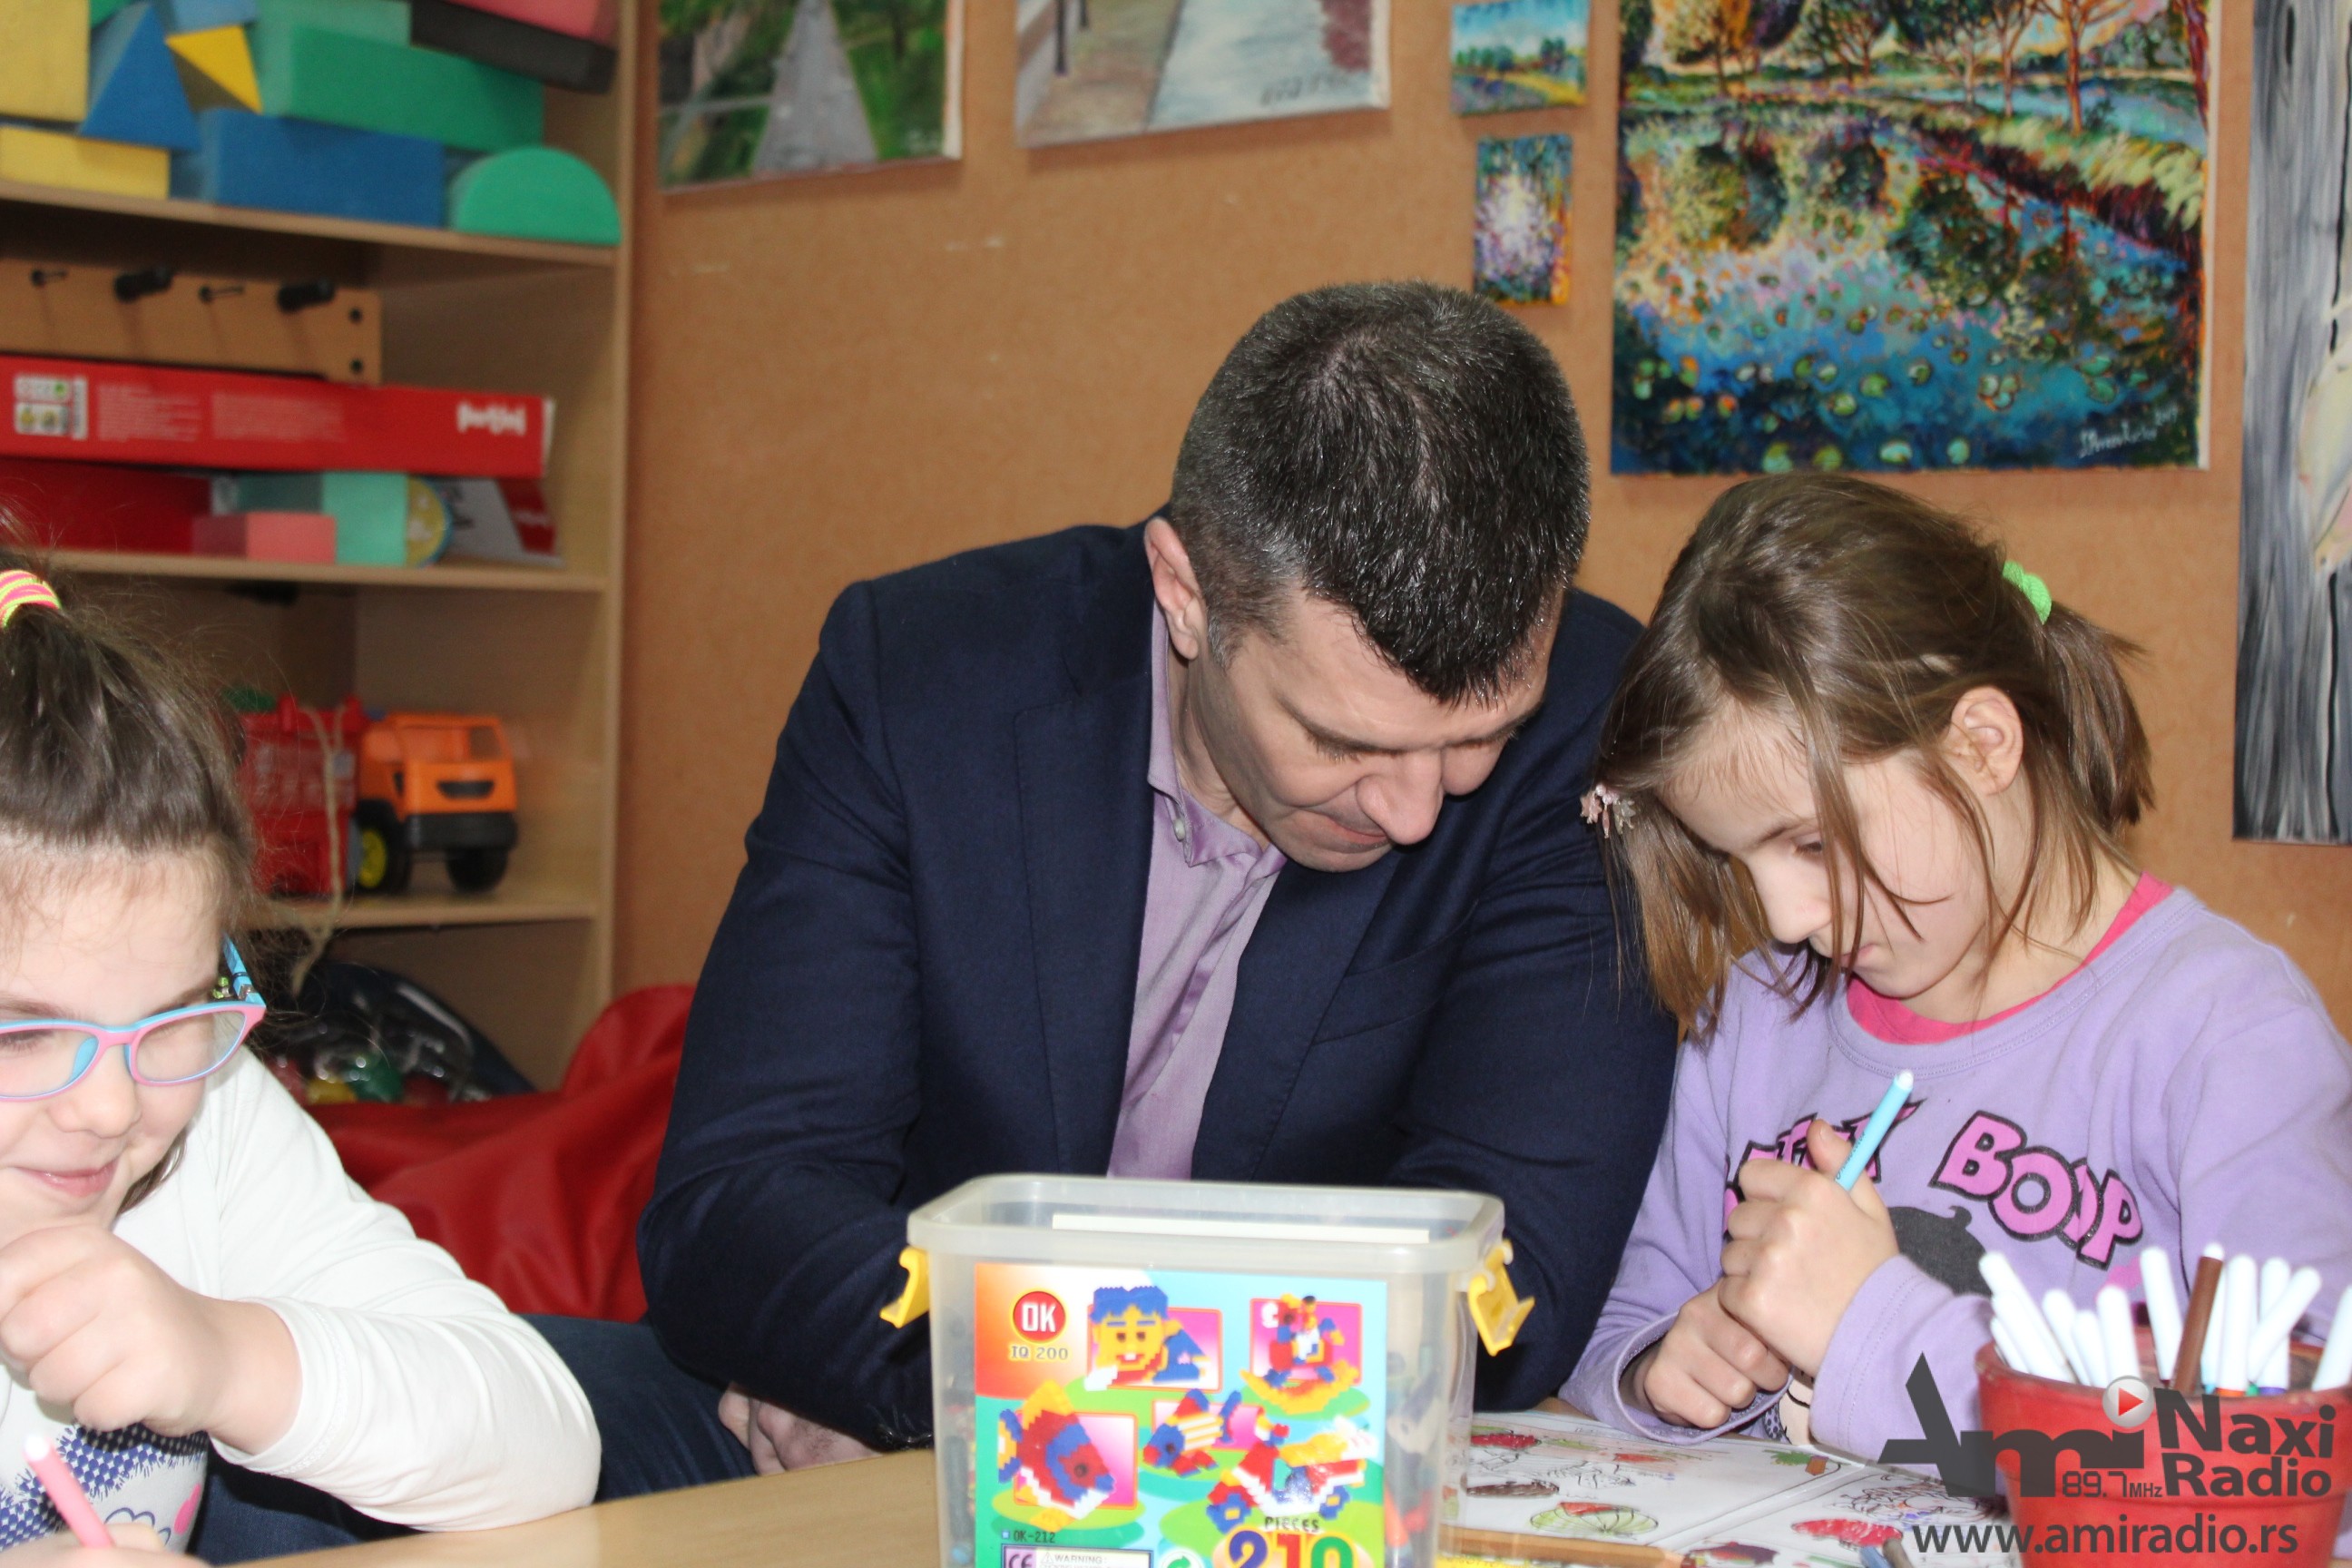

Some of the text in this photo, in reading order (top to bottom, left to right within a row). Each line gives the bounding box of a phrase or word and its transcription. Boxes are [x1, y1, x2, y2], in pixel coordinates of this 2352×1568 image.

[1022, 1303, 1056, 1332] OK
[1011, 1346, 1069, 1360] IQ 200
[1265, 1516, 1320, 1532] PIECES
[1013, 1530, 1056, 1543] OK-212
